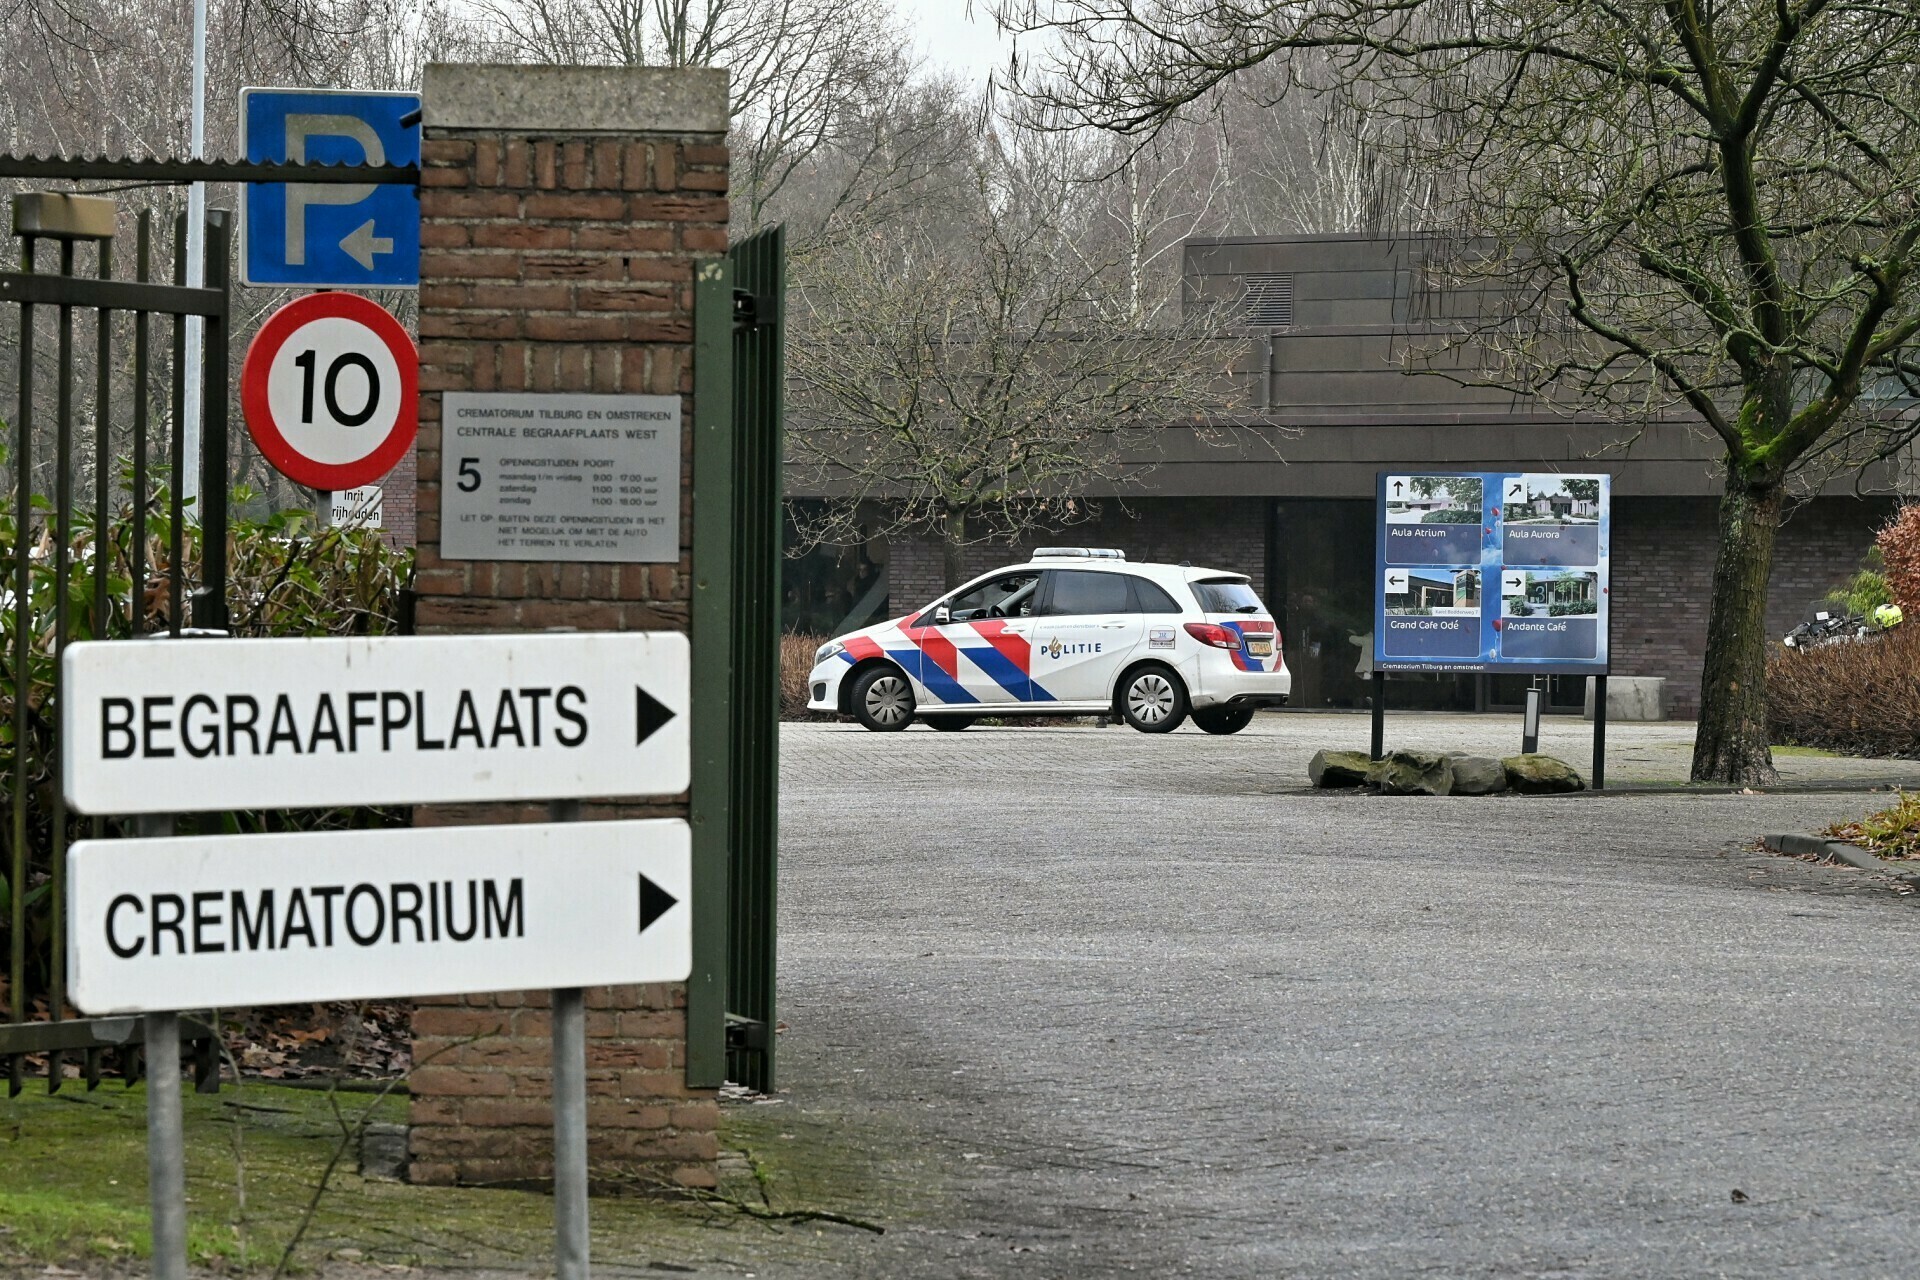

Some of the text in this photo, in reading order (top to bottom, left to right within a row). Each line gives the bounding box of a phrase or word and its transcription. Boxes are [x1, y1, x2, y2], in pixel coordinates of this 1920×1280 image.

[285, 114, 386, 266] P
[295, 349, 381, 427] 10
[457, 408, 671, 421] CREMATORIUM TILBURG EN OMSTREKEN
[457, 427, 658, 440] CENTRALE BEGRAAFPLAATS WEST
[584, 459, 616, 468] POORT
[457, 457, 482, 493] 5
[344, 490, 364, 501] Inrit
[460, 514, 476, 522] LET
[533, 516, 556, 524] DEZE
[636, 516, 645, 524] IS
[648, 517, 666, 525] HET
[498, 526, 518, 534] NIET
[608, 528, 620, 536] DE
[623, 528, 648, 537] AUTO
[1391, 528, 1446, 538] Aula Atrium
[1508, 530, 1560, 540] Aula Aurora
[498, 538, 618, 548] HET TERREIN TE VERLATEN
[1390, 620, 1416, 629] Grand
[1440, 620, 1459, 630] Odé
[1508, 622, 1567, 632] Andante Café
[1041, 642, 1102, 660] POLITIE
[101, 685, 589, 760] BEGRAAFPLAATS
[105, 878, 526, 959] CREMATORIUM
